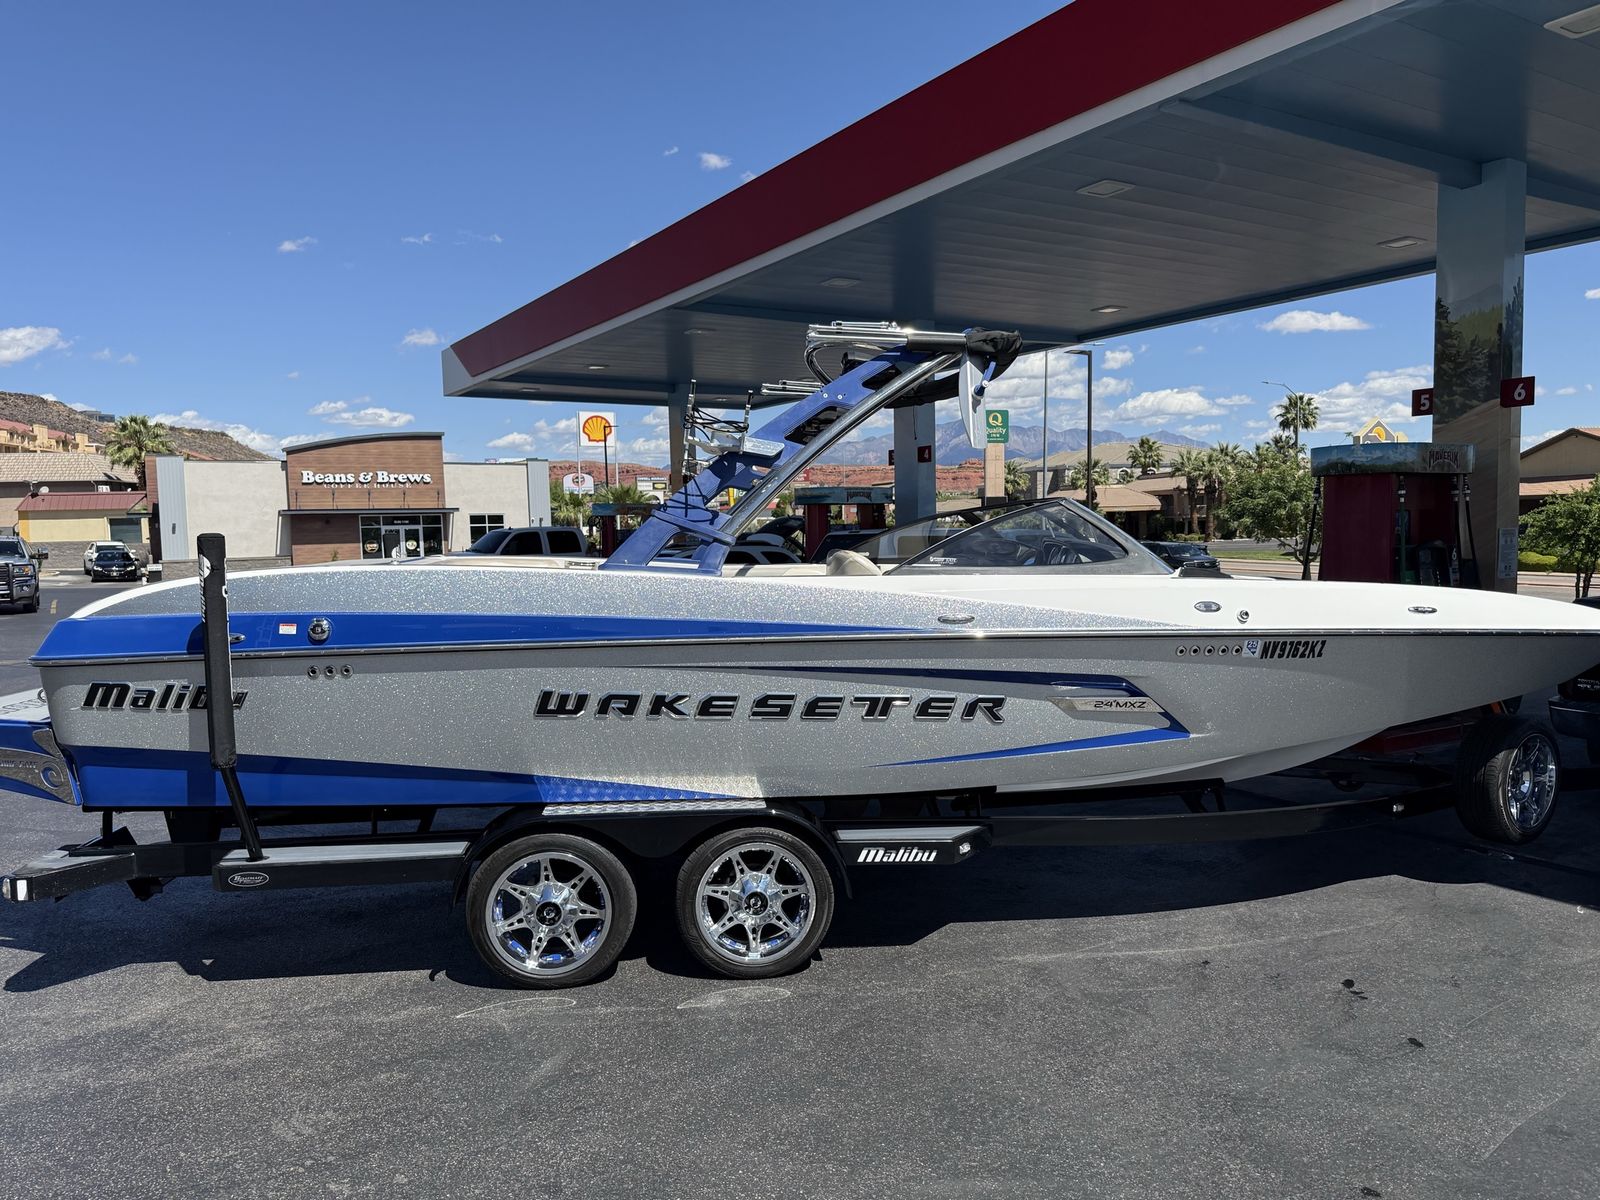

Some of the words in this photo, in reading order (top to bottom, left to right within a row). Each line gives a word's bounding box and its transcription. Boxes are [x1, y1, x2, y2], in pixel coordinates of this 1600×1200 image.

[1513, 383, 1526, 400] 6
[1420, 394, 1430, 411] 5
[988, 412, 1003, 426] Q
[923, 449, 929, 459] 4
[301, 470, 355, 484] Beans
[358, 471, 373, 484] &
[376, 470, 432, 484] Brews
[533, 689, 1006, 724] WAKESETTER
[857, 846, 937, 862] Malibu
